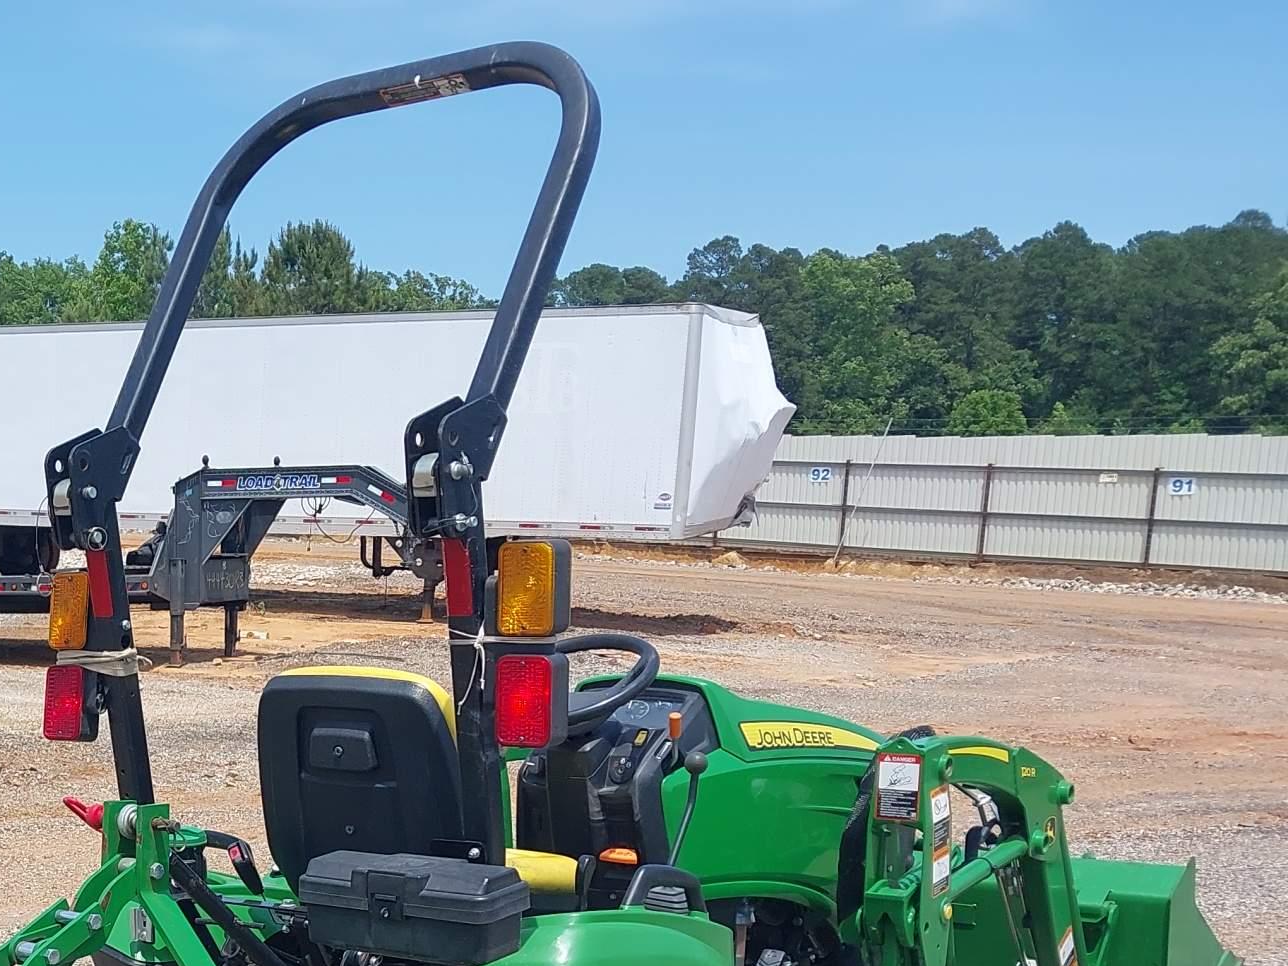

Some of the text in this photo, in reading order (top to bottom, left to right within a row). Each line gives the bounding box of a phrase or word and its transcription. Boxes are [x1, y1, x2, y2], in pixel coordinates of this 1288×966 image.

[812, 468, 830, 480] 92
[237, 475, 320, 490] LOAD TRAIL
[1172, 479, 1193, 493] 91
[757, 727, 834, 745] JOHN DEERE
[891, 755, 917, 763] DANGER
